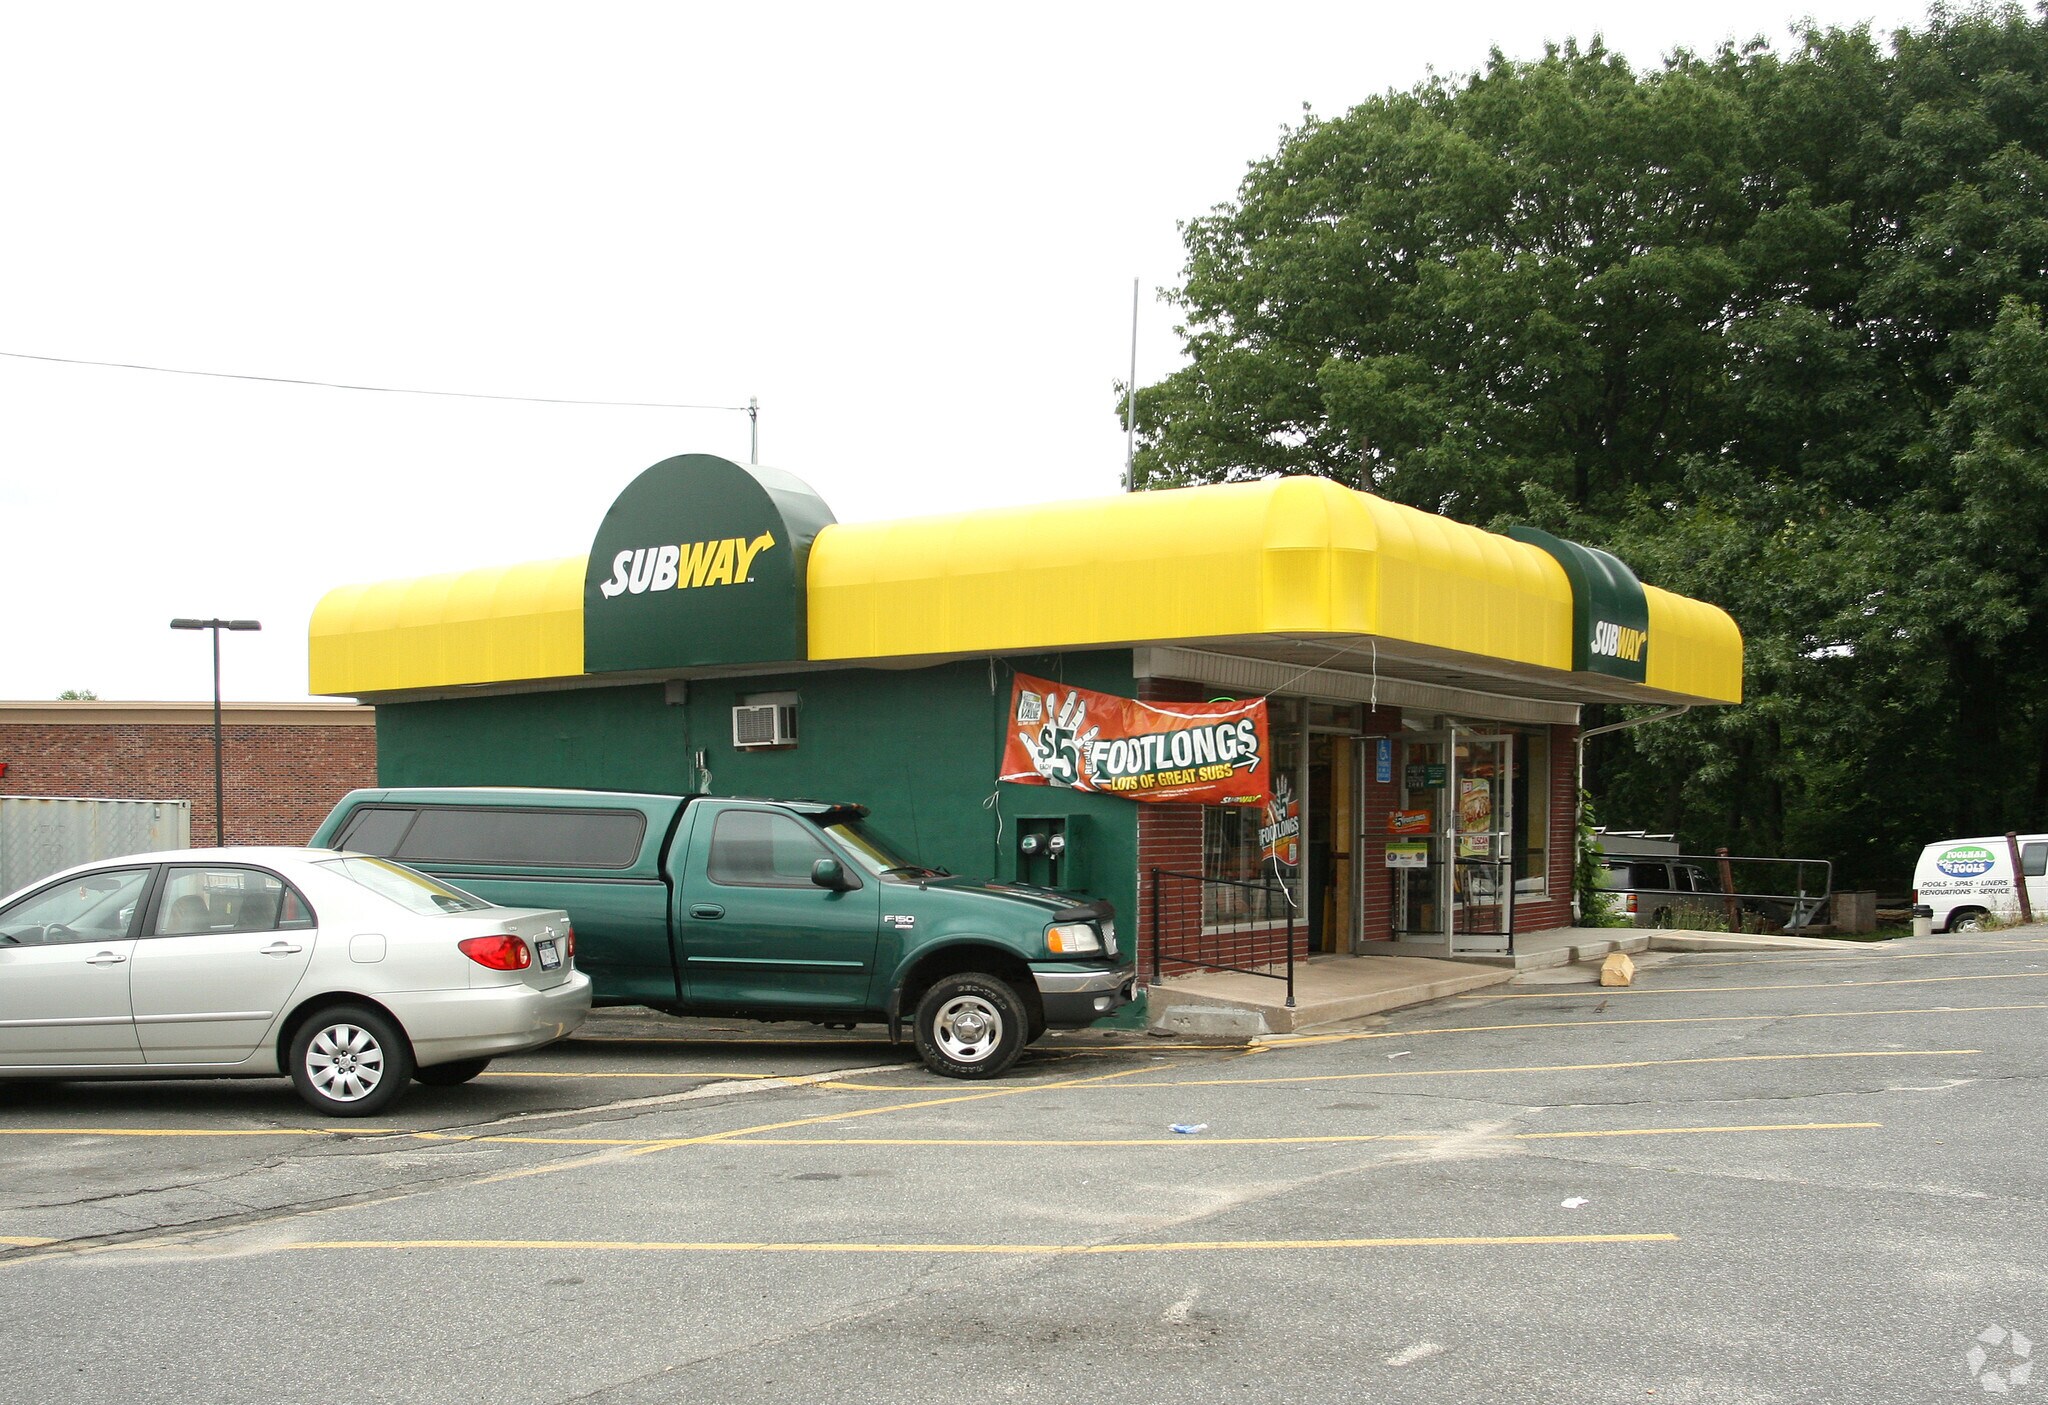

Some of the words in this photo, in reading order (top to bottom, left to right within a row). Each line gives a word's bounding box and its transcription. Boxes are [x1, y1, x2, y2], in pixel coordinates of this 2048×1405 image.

[600, 531, 775, 599] SUBWAY
[1590, 620, 1647, 662] SUBWAY
[1037, 725, 1078, 784] $5
[1083, 740, 1094, 775] REGULAR
[1091, 719, 1258, 775] FOOTLONGS
[1111, 776, 1137, 791] LOTS
[1140, 773, 1154, 788] OF
[1158, 769, 1197, 786] GREAT
[1199, 763, 1234, 782] SUBS
[1946, 851, 1987, 859] POOLMAN
[1952, 863, 1986, 873] POOLS
[1979, 887, 2010, 895] SERVICE
